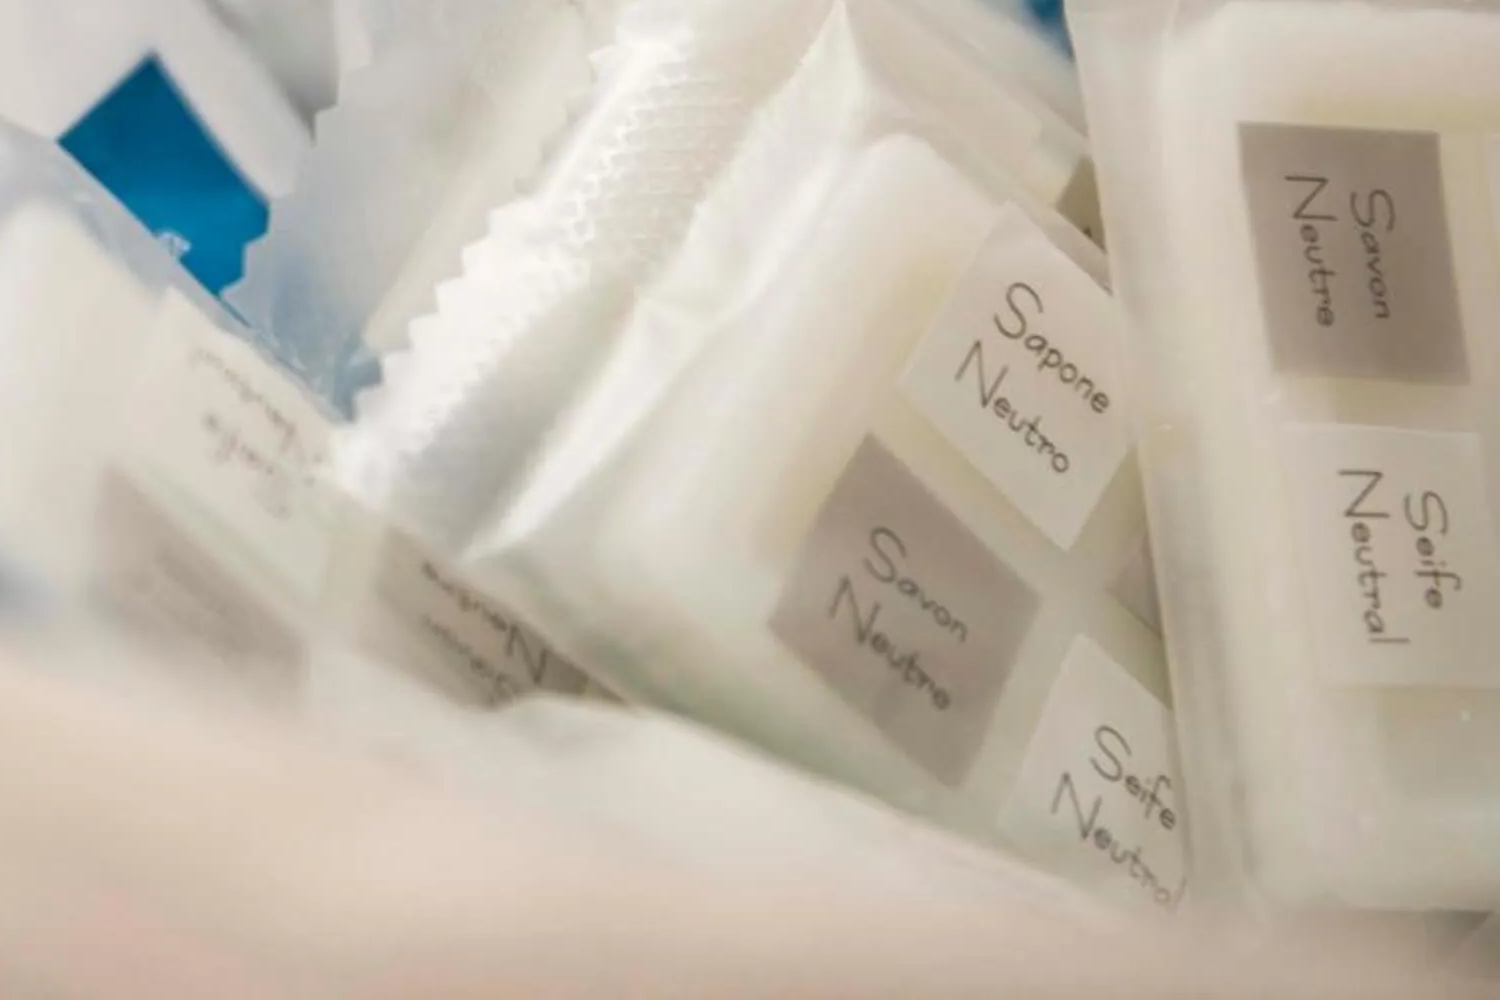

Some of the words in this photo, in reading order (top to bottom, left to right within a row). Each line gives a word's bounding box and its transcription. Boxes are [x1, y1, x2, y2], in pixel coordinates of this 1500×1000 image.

[1284, 173, 1338, 330] Neutre
[1350, 187, 1397, 321] Savon
[954, 339, 1071, 475] Neutro
[992, 281, 1111, 415] Sapone
[862, 525, 968, 645] Savon
[1336, 468, 1411, 646] Neutral
[1403, 489, 1463, 611] Seife
[827, 575, 952, 712] Neutre
[1050, 770, 1189, 915] Neutral
[1088, 724, 1177, 832] Seife
